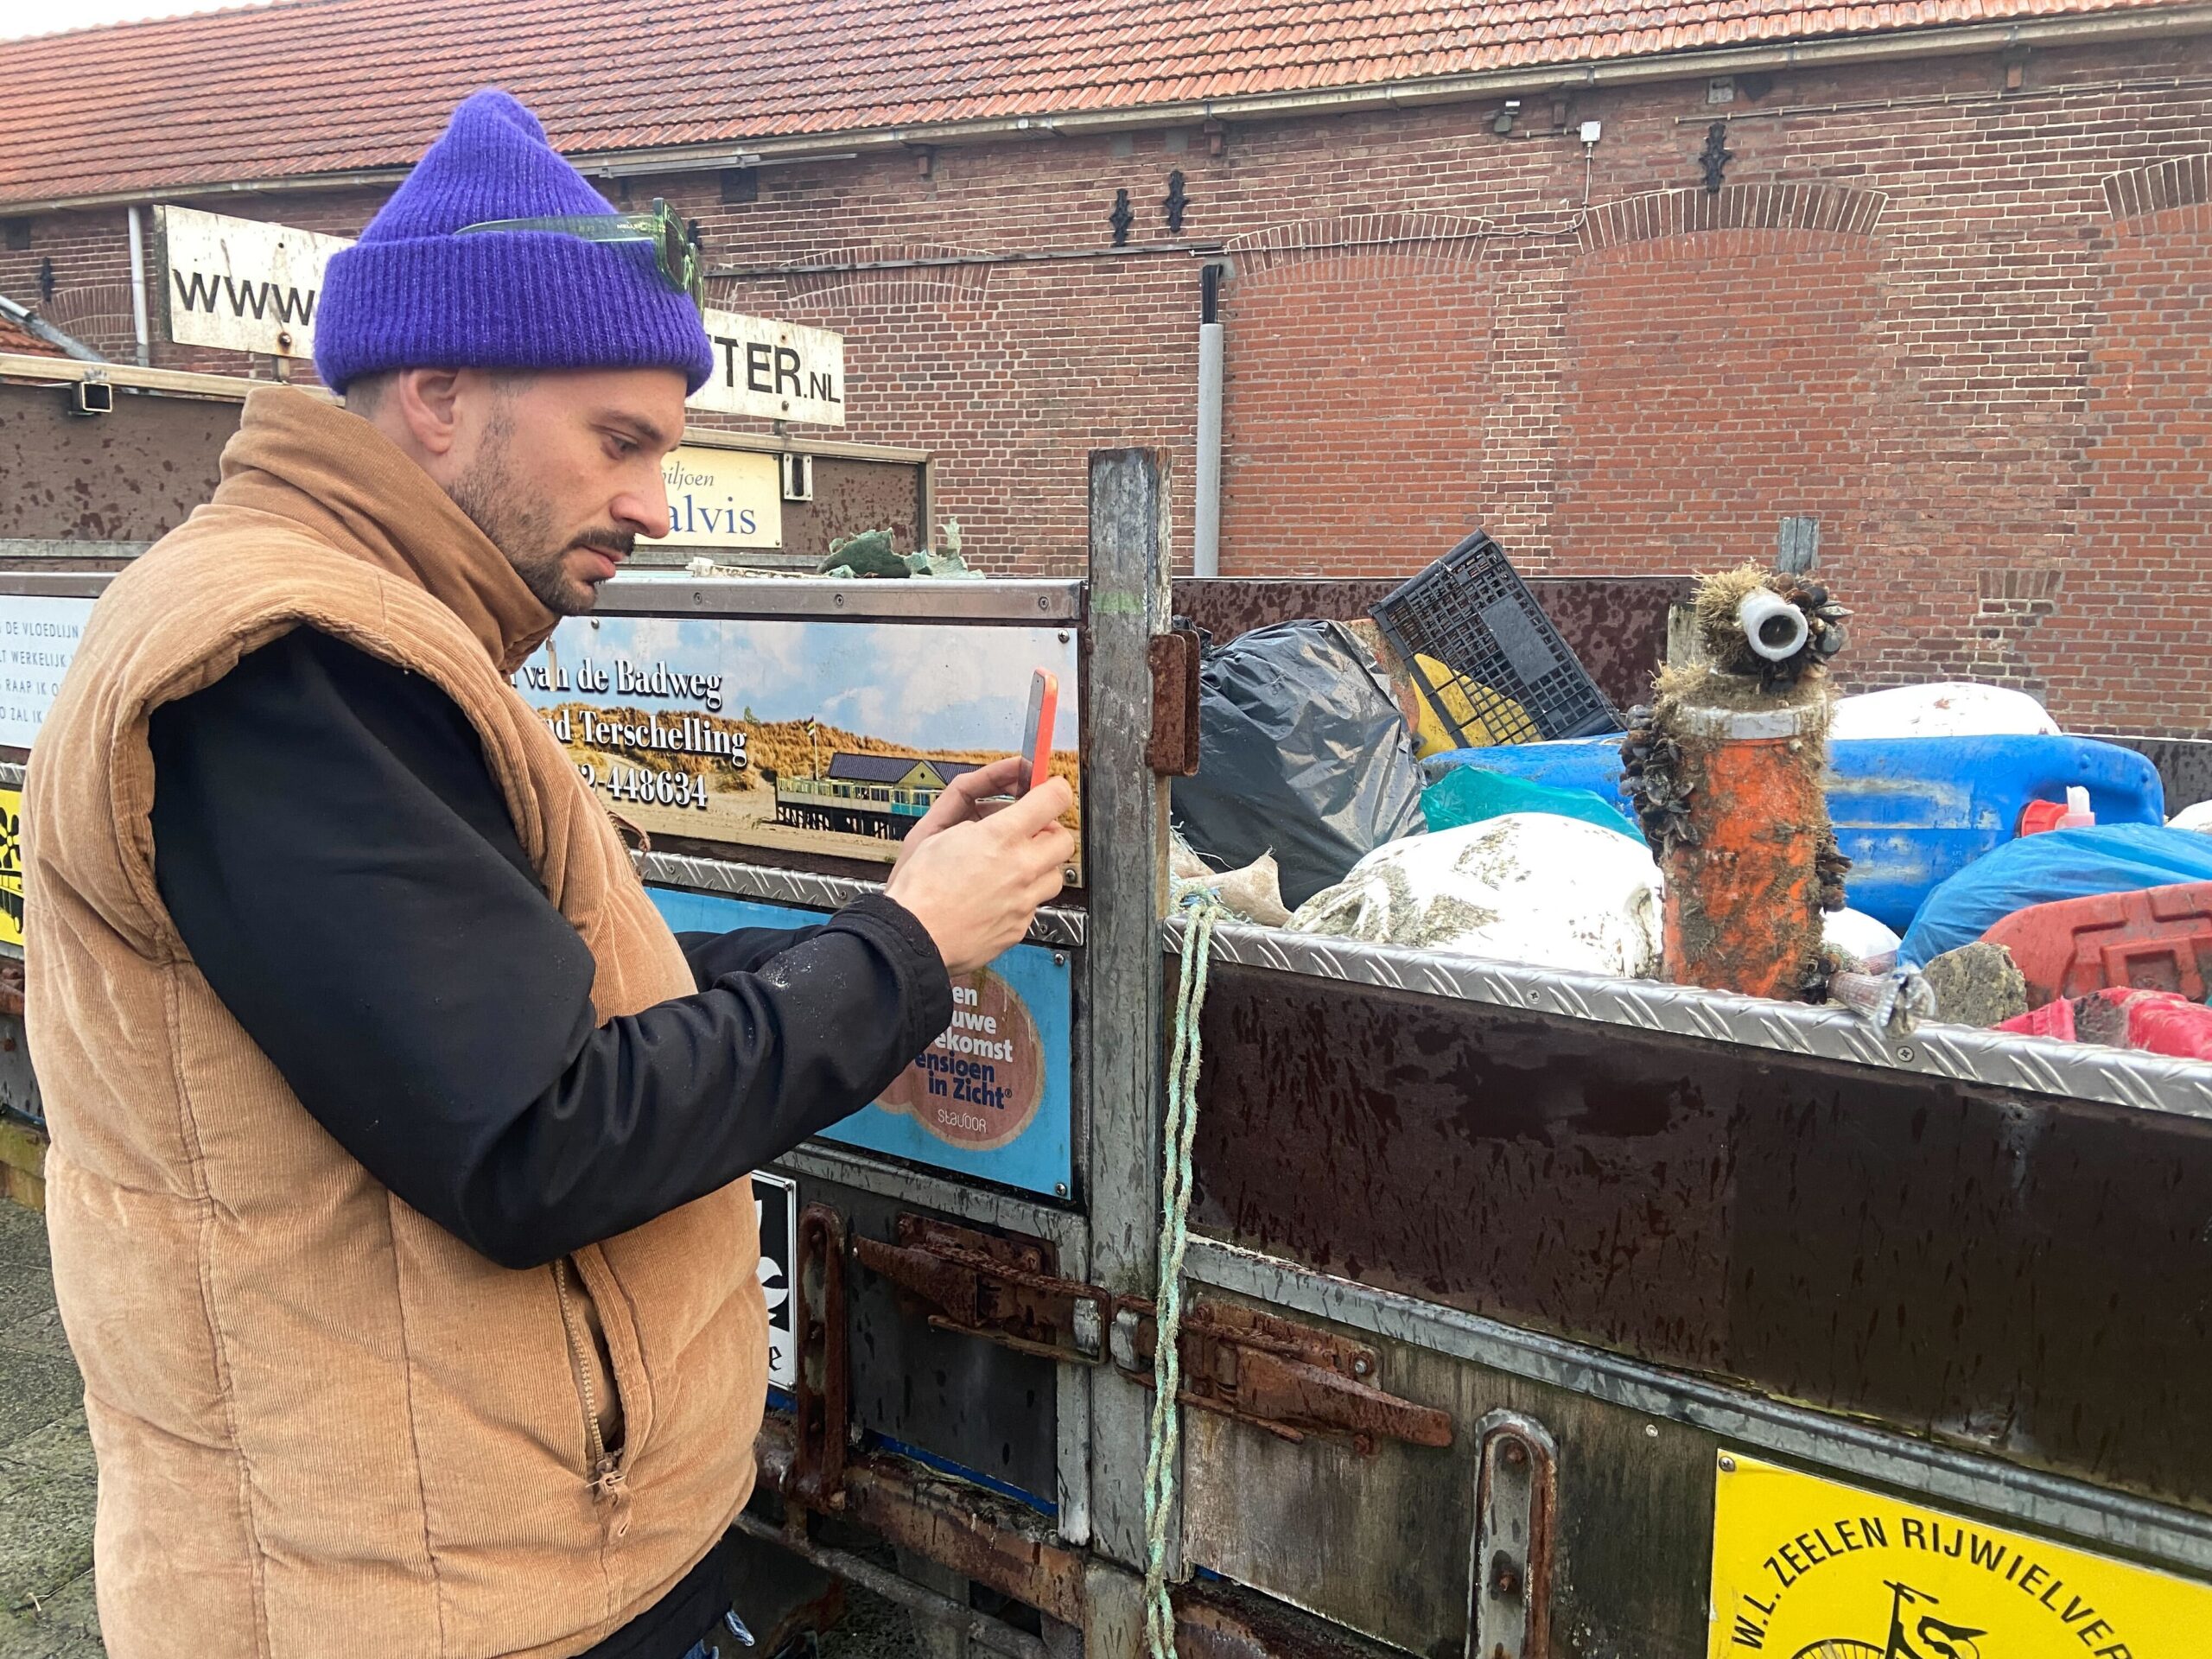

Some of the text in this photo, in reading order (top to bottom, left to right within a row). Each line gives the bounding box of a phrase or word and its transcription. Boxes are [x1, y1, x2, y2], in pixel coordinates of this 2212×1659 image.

[707, 334, 841, 404] TER.NL
[6, 621, 79, 638] DE VLOEDLIJN
[11, 651, 67, 667] WERKELIJK
[5, 678, 31, 693] RAAP
[36, 681, 47, 695] IK
[578, 657, 609, 691] de
[615, 658, 723, 710] Badweg
[11, 707, 28, 721] ZAL
[33, 709, 42, 723] IK
[579, 710, 748, 767] Terschelling
[577, 764, 709, 808] 2-448634
[929, 1071, 948, 1096] in
[1763, 1517, 1888, 1588] ZEELEN
